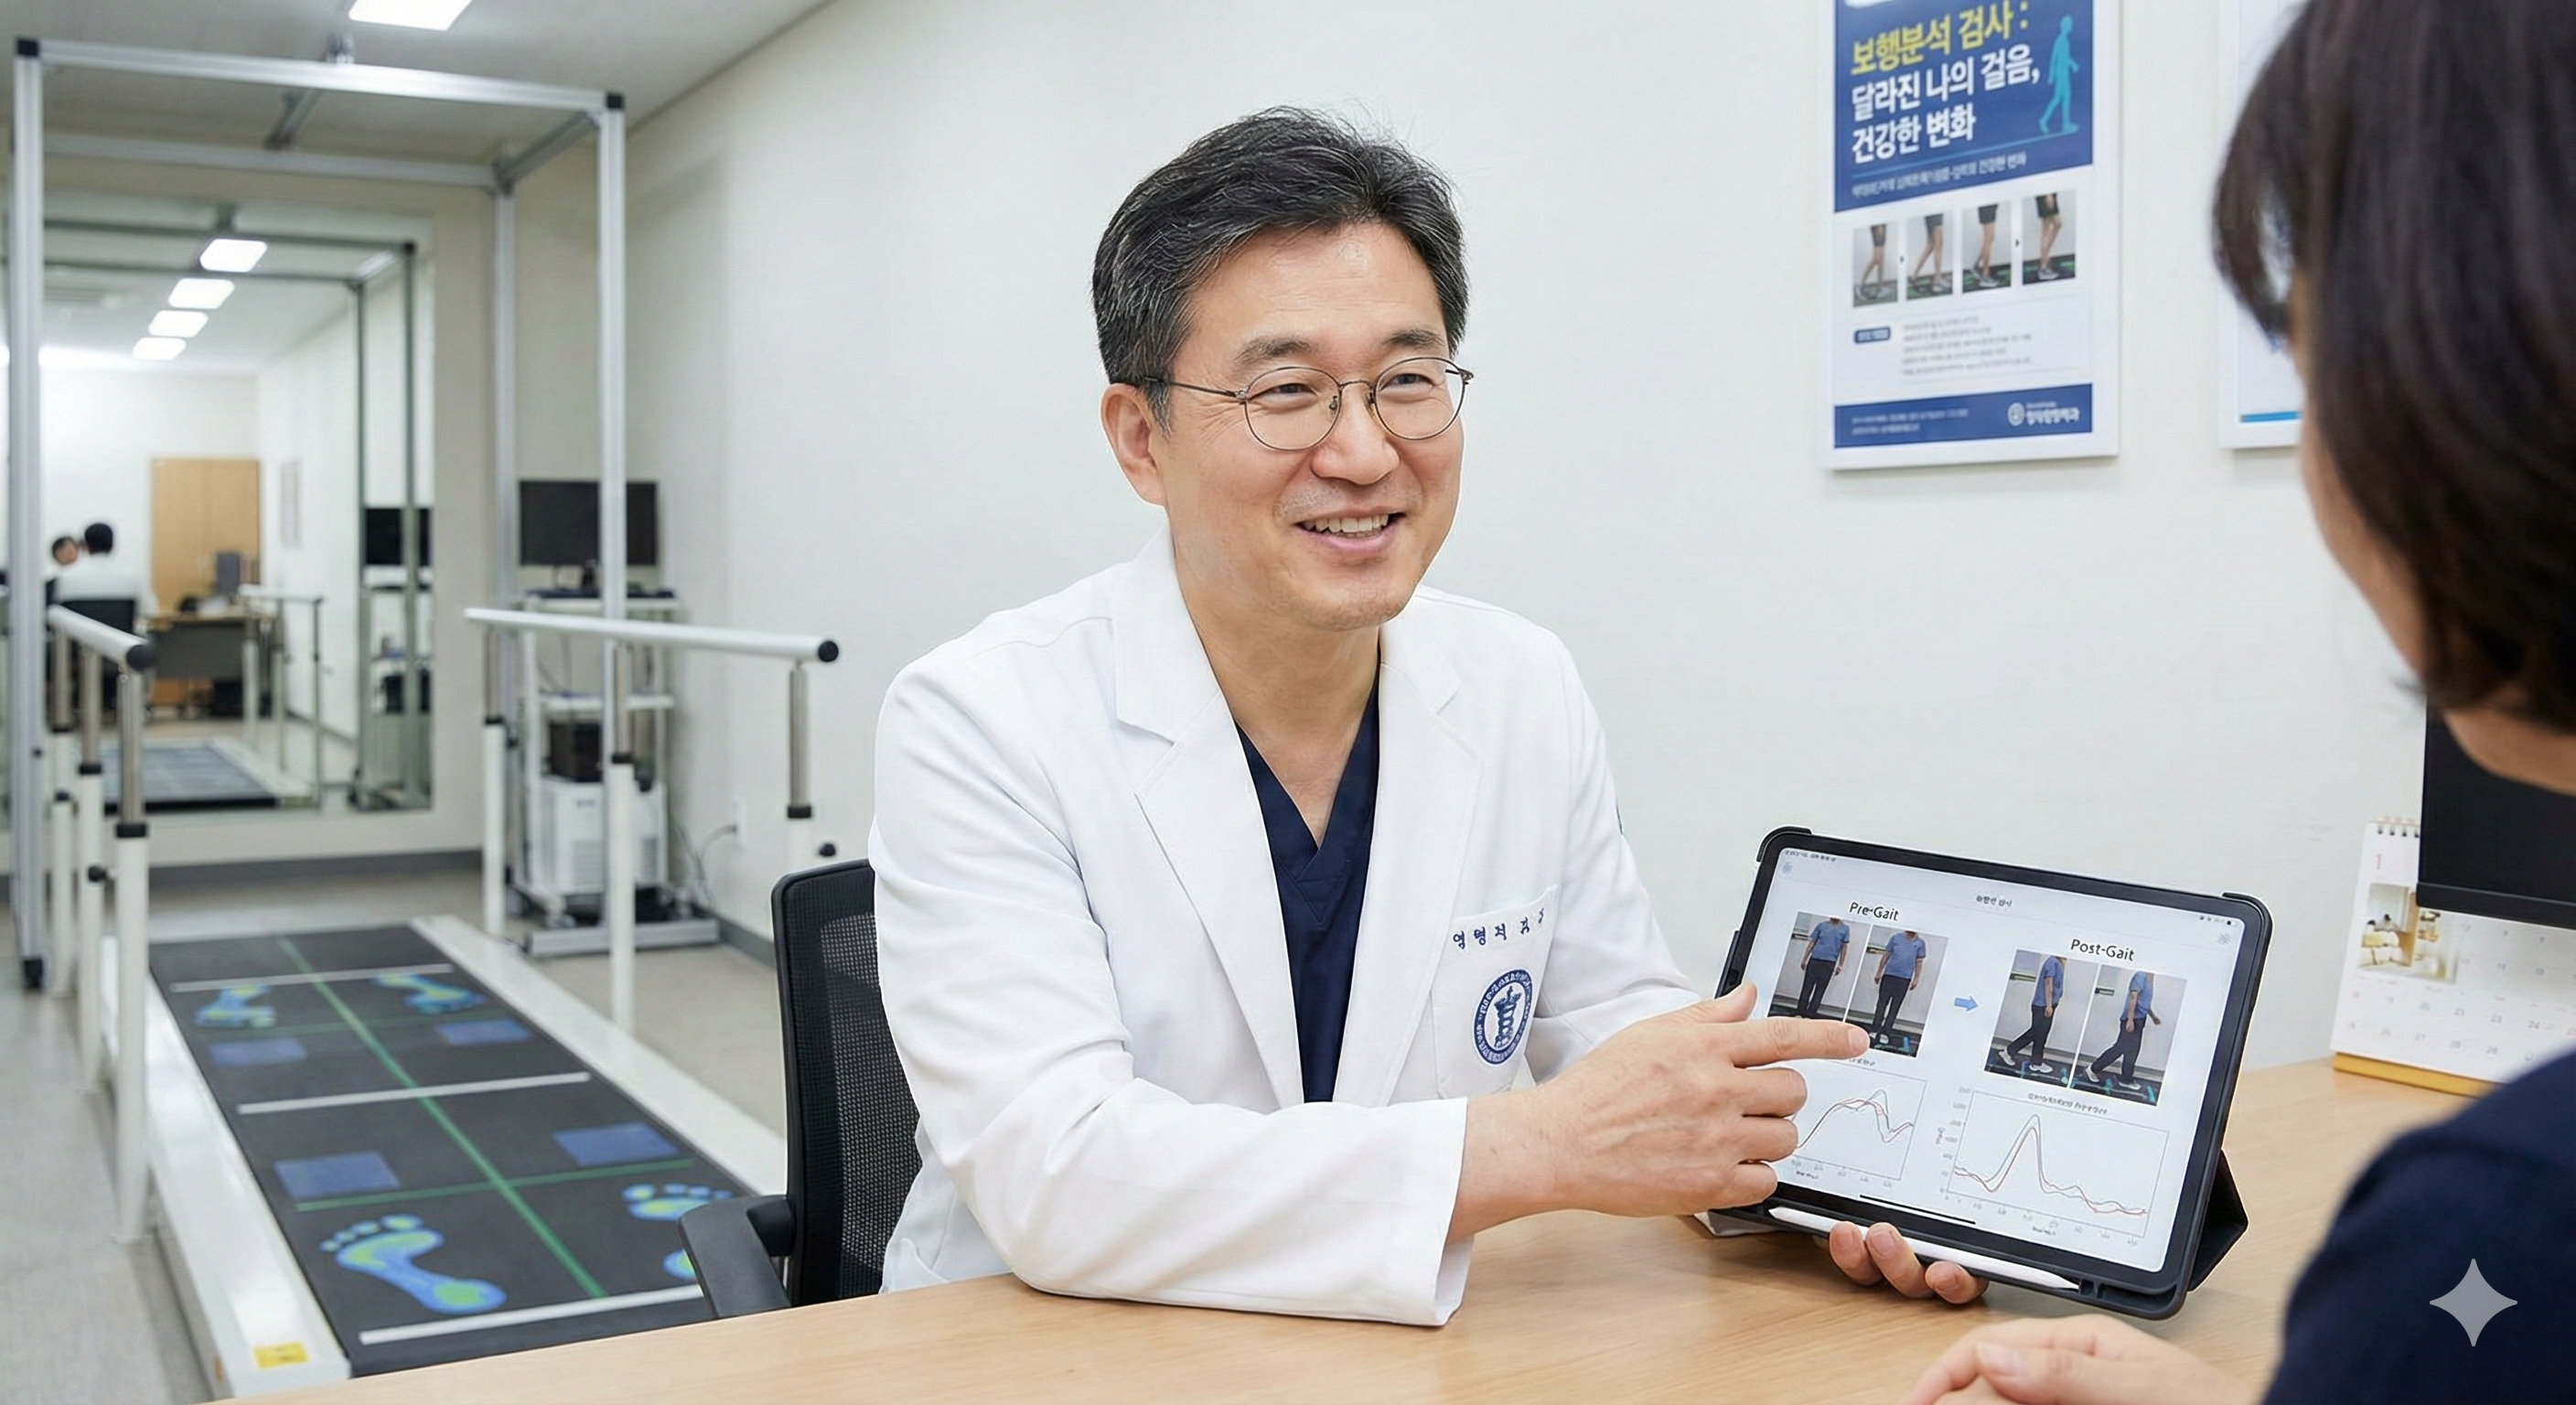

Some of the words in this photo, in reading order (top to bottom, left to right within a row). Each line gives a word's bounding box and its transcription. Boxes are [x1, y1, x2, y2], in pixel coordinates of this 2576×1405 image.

[1851, 13, 1951, 76] 보행분석
[1959, 0, 2014, 50] 검사
[1852, 70, 1921, 123] 달라진
[1926, 56, 1975, 102] 나의
[1980, 43, 2041, 91] 걸음,
[1852, 113, 1922, 165] 건강한
[1926, 102, 1977, 148] 변화
[1849, 901, 1899, 922] Pre-Gait
[2070, 938, 2134, 961] Post-Gait
